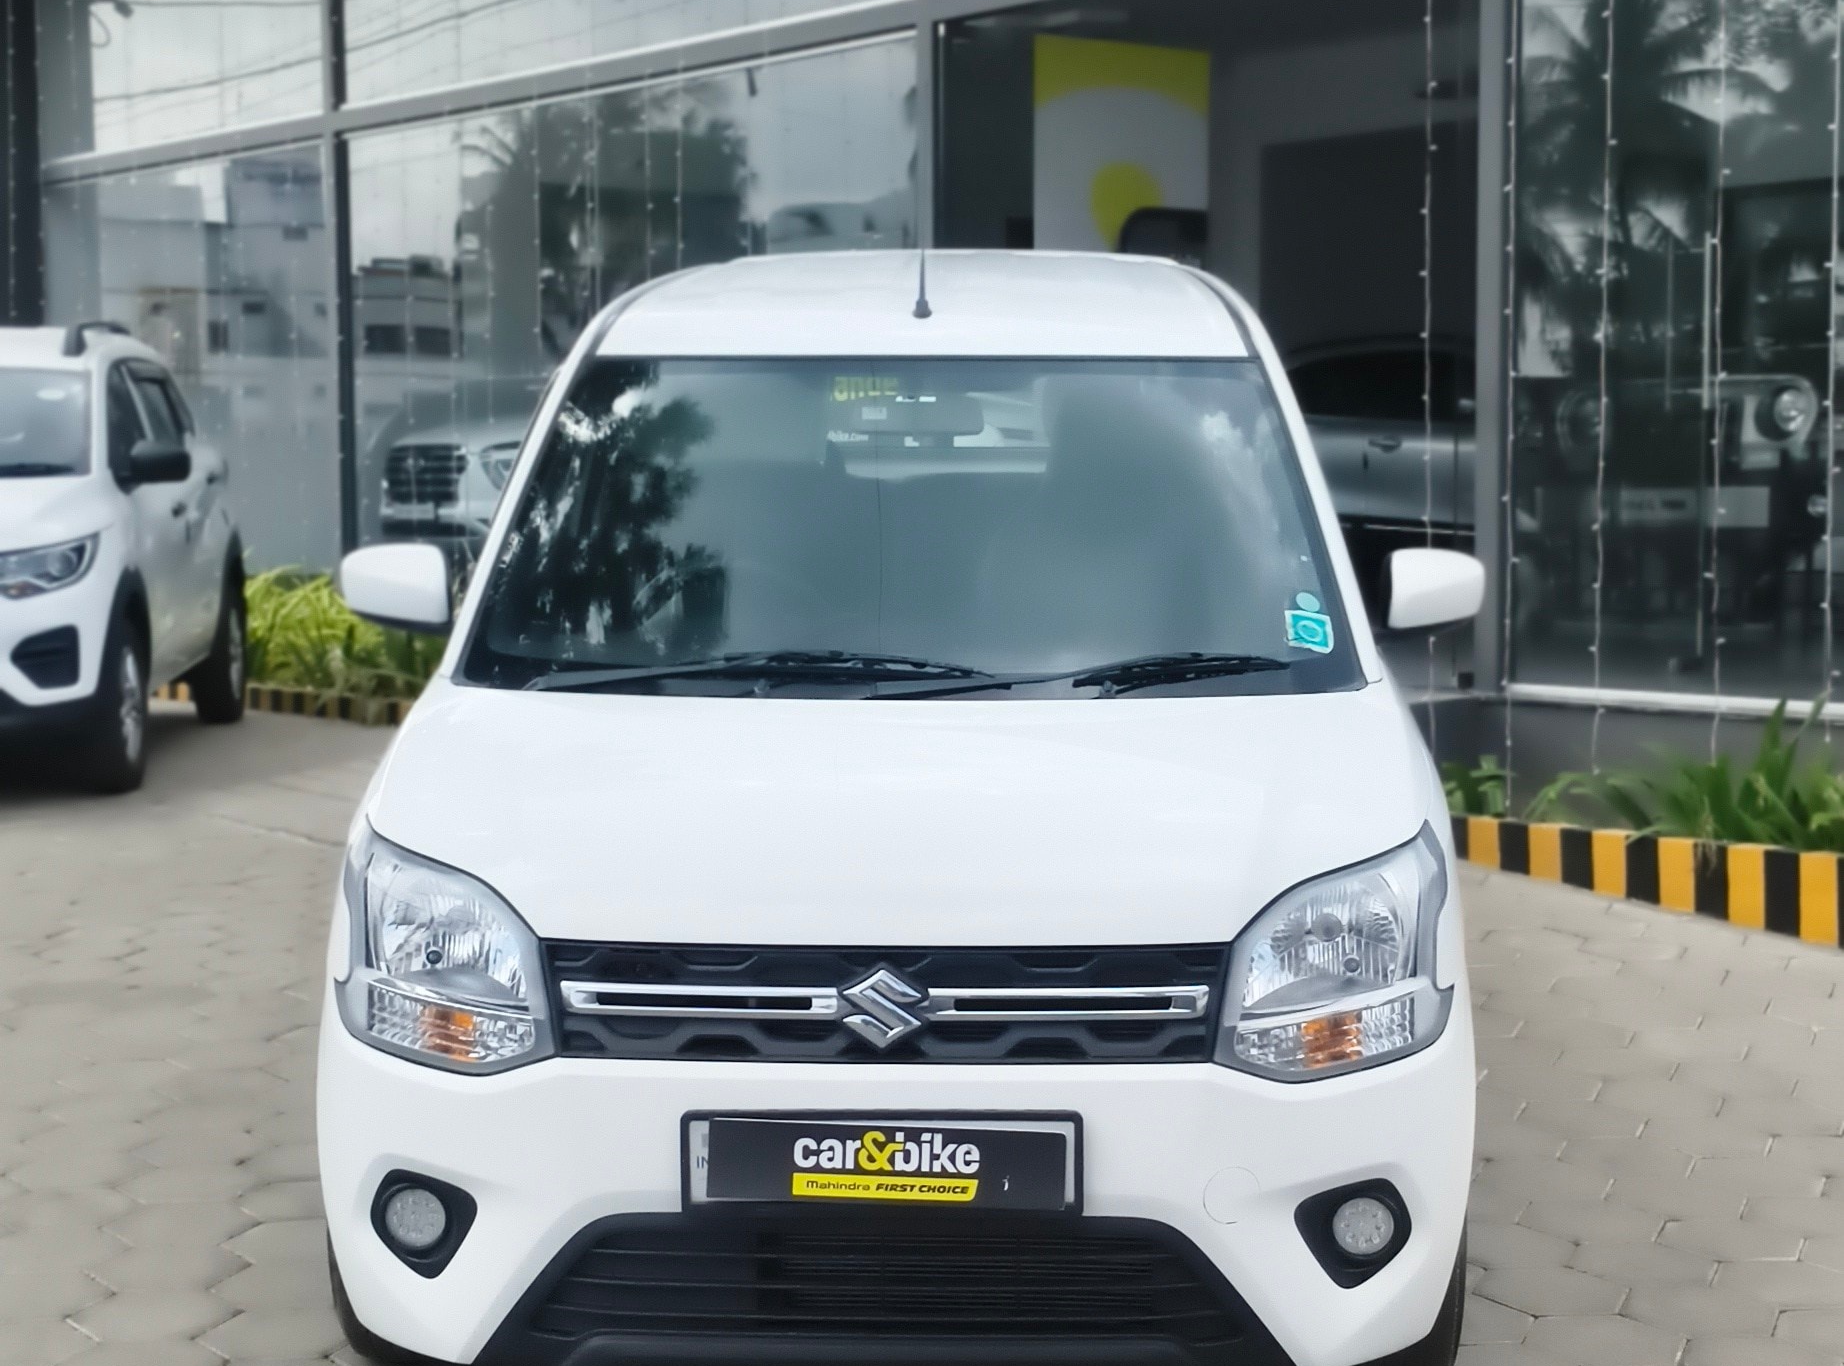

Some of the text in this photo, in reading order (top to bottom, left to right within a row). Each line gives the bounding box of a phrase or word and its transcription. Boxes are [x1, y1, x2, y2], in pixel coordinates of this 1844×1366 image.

[793, 1130, 981, 1175] car&bike
[805, 1179, 970, 1195] Mahindra FIRST CHOICE
